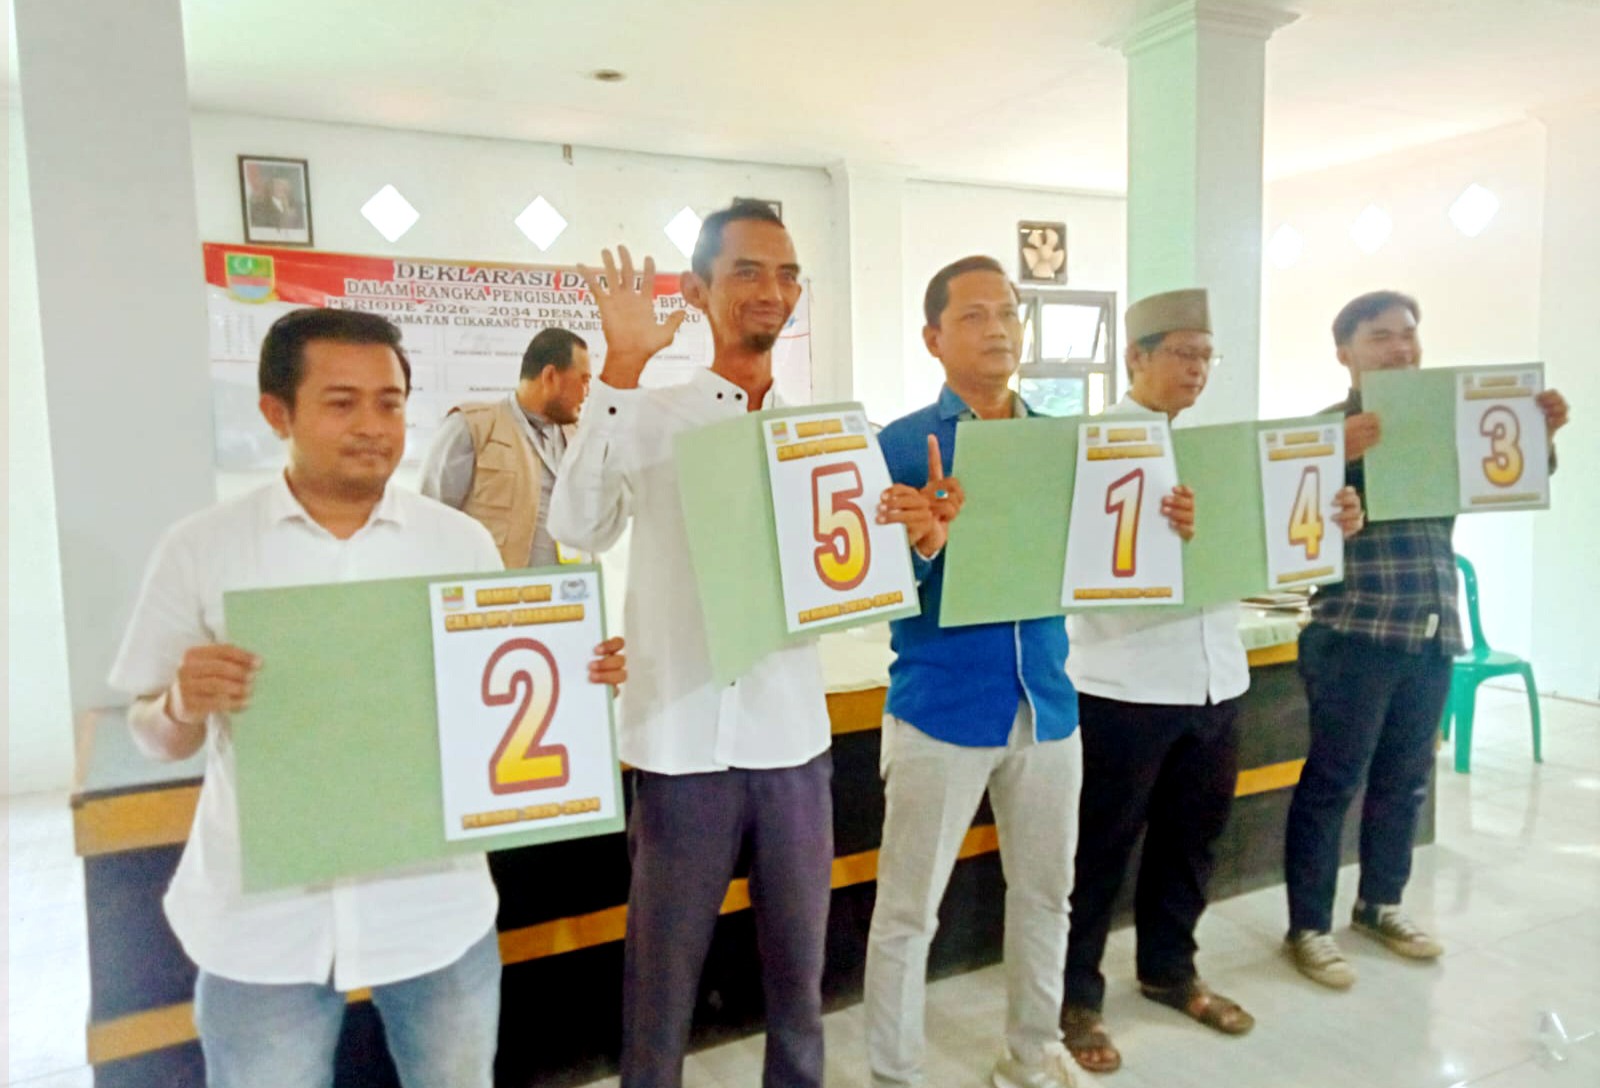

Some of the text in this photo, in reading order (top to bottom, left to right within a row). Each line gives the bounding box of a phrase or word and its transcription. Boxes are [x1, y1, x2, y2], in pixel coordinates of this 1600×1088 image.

[328, 298, 416, 312] PERIODE
[424, 303, 470, 314] 2026
[488, 306, 531, 317] 2034
[538, 308, 583, 319] DESA
[346, 281, 409, 297] DALAM
[415, 284, 487, 301] RANGKA
[492, 292, 576, 305] PENGISIAN
[660, 296, 687, 309] BPD
[397, 263, 554, 286] DEKLARASI
[384, 313, 449, 325] CAMATAN
[453, 316, 520, 328] CIKARANG
[524, 318, 563, 329] UTARA
[1480, 404, 1524, 488] 3
[811, 461, 871, 591] 5
[1105, 468, 1144, 577] 1
[1288, 465, 1324, 560] 4
[481, 637, 570, 795] 2
